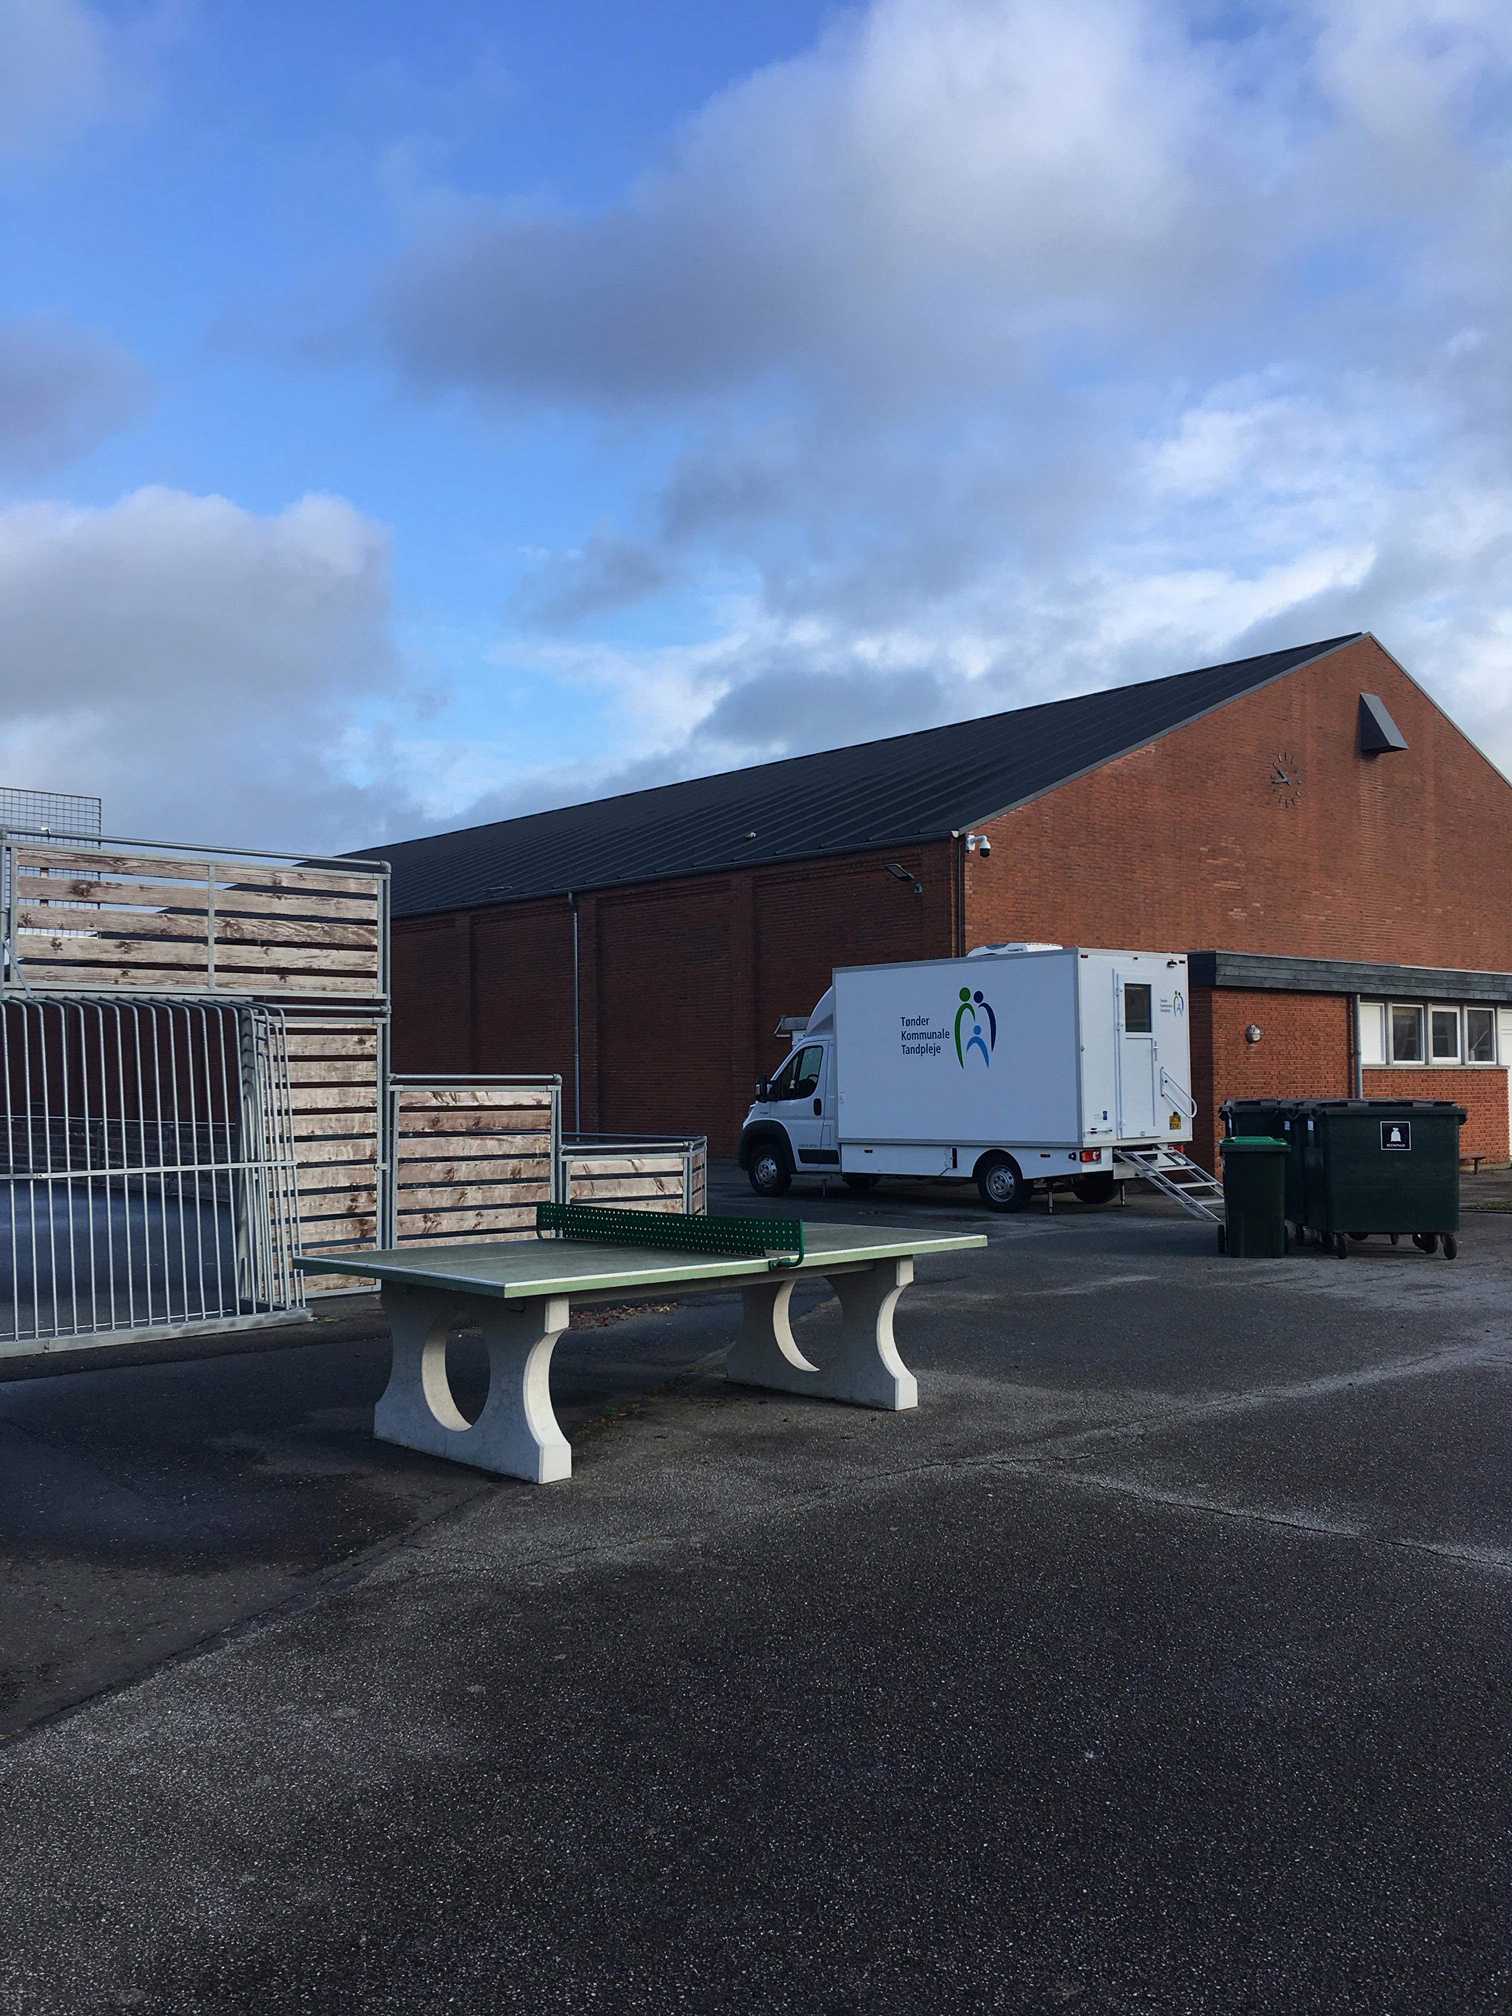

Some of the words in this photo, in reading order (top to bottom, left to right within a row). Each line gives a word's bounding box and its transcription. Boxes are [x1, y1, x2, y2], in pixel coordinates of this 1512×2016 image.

[901, 1015, 930, 1027] Tønder
[901, 1029, 950, 1041] Kommunale
[902, 1043, 941, 1056] Tandpleje
